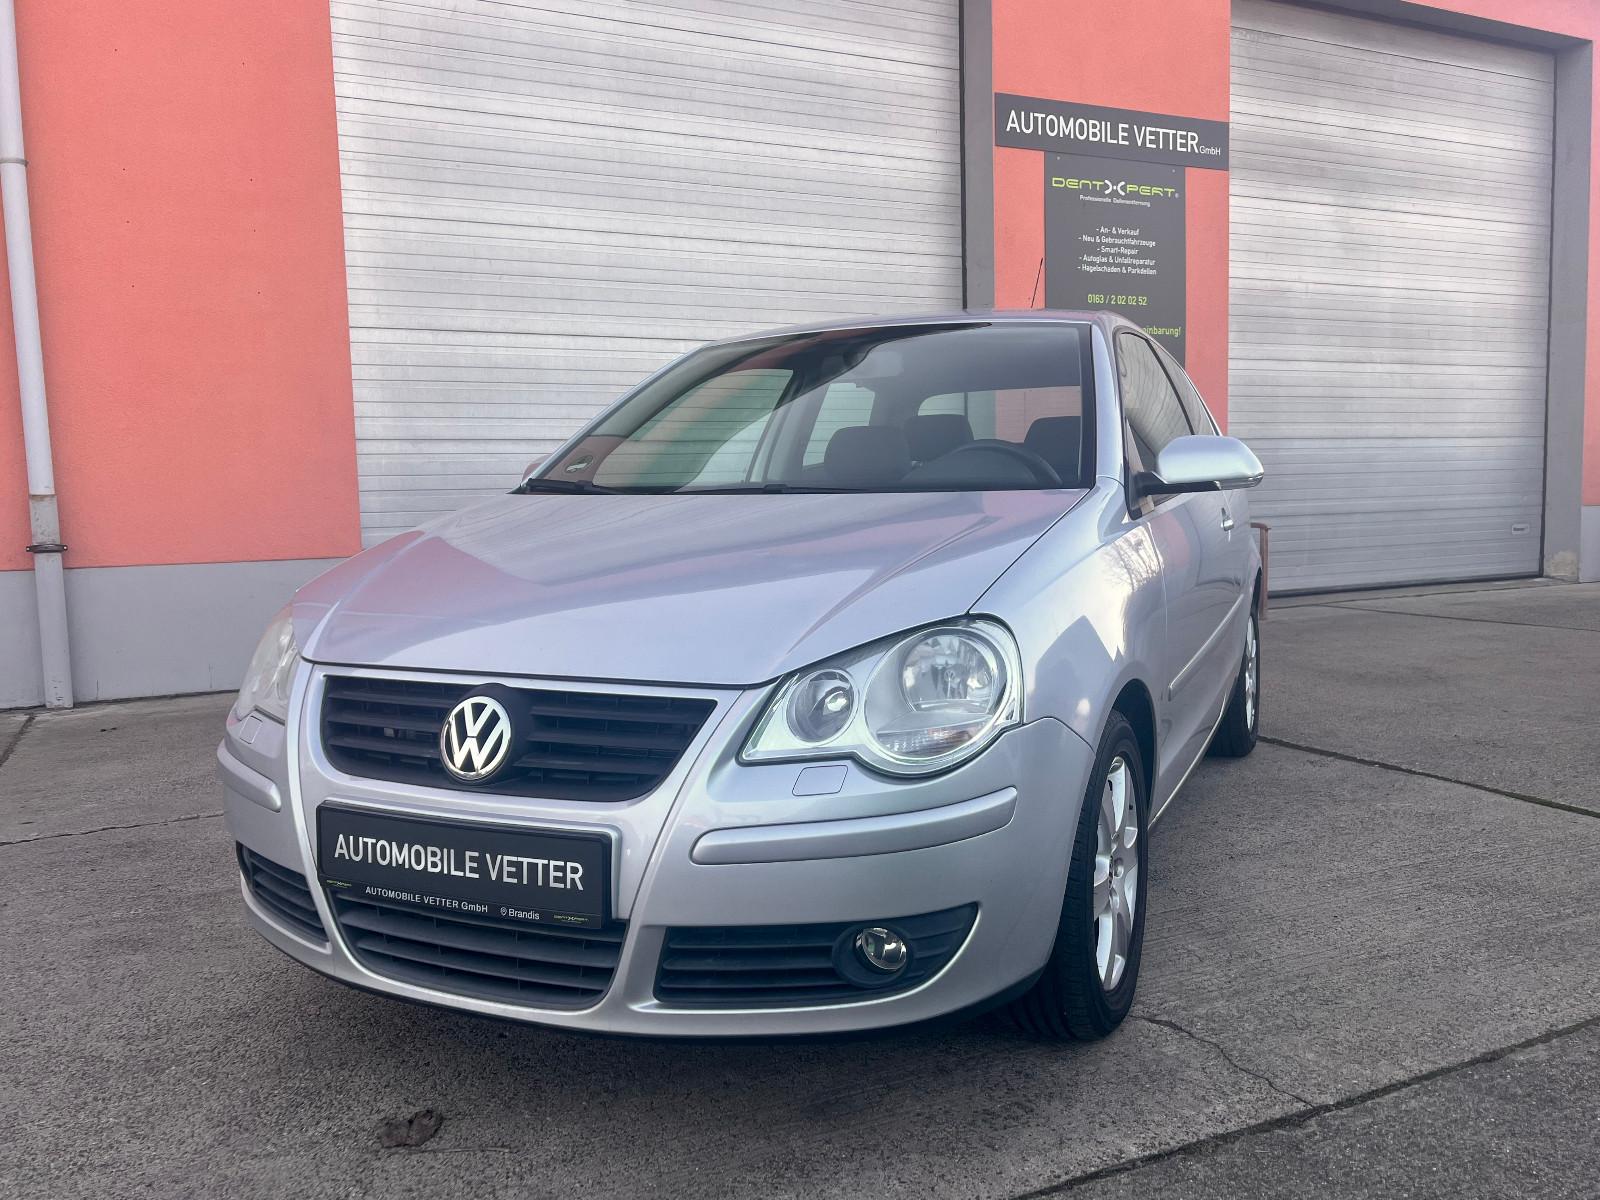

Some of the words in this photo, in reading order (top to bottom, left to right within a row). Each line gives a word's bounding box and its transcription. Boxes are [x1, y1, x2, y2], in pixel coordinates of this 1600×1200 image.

[1006, 109, 1129, 146] AUTOMOBILE
[1134, 124, 1199, 154] VETTER
[1199, 145, 1221, 157] GmbH
[1100, 225, 1111, 234] An-
[1111, 226, 1117, 235] &
[1117, 227, 1140, 236] Verkauf
[1082, 234, 1095, 243] Neu
[1095, 235, 1101, 243] &
[1101, 245, 1139, 256] Smart-Repair
[1083, 253, 1108, 264] Autoglas
[1108, 255, 1114, 264] &
[1121, 266, 1127, 274] &
[1087, 294, 1105, 304] 0163
[1110, 295, 1116, 305] 2
[1117, 295, 1127, 305] 02
[1127, 295, 1137, 306] 02
[1138, 296, 1148, 306] 52
[334, 834, 480, 879] AUTOMOBILE
[485, 853, 584, 891] VETTER
[365, 886, 422, 903] AUTOMOBILE
[423, 896, 459, 909] VETTER
[461, 902, 488, 913] GmbH
[508, 908, 540, 920] Brandis
